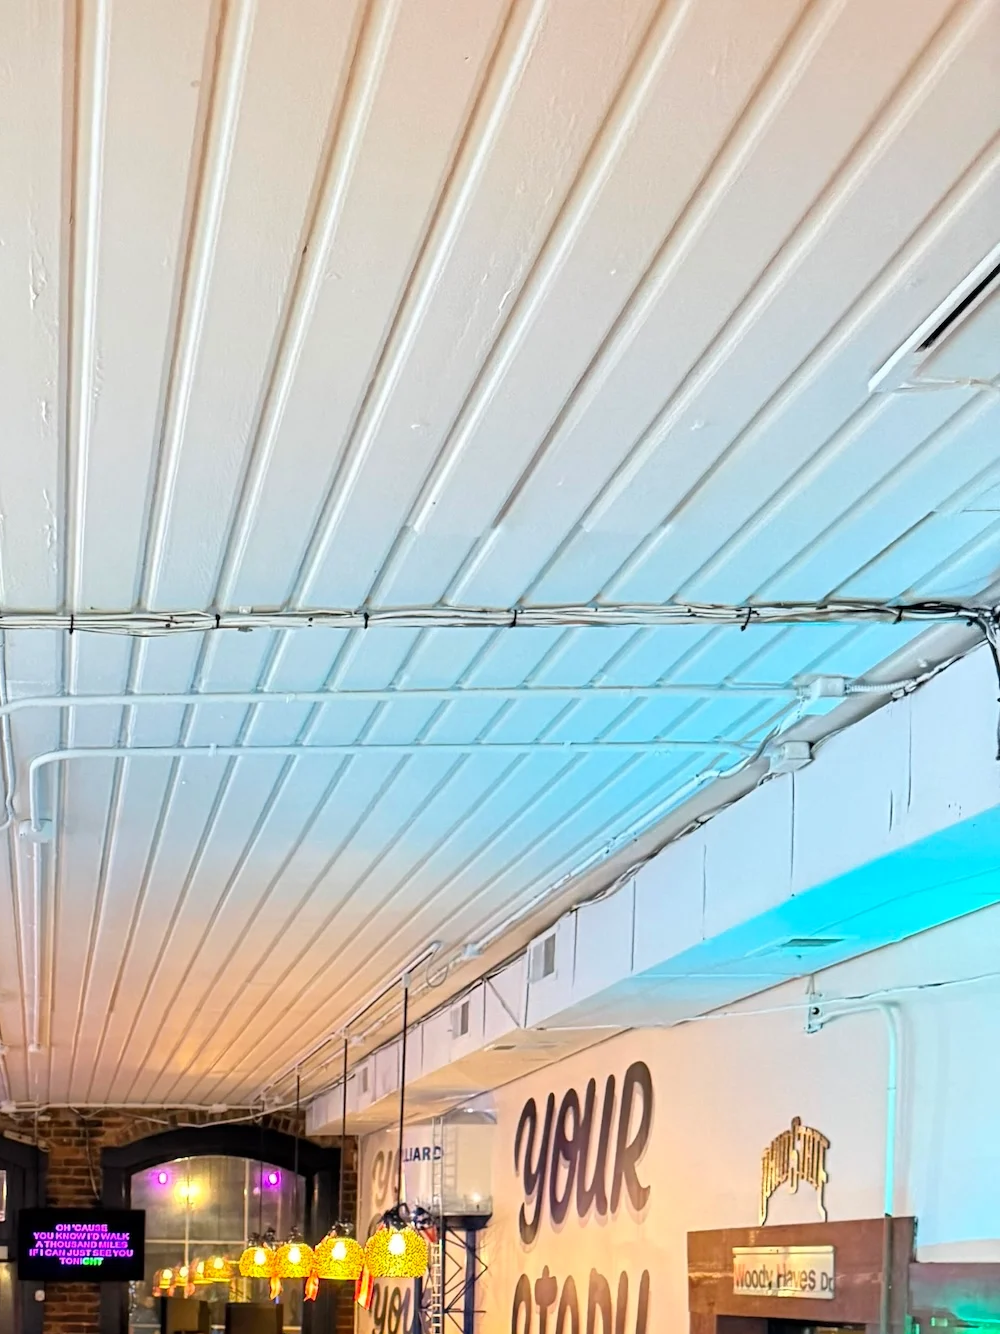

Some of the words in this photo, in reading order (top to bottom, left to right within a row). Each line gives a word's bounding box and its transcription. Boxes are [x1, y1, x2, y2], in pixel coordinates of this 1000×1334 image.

[514, 1060, 653, 1245] YOUR
[33, 1232, 54, 1240] YOU
[55, 1232, 86, 1240] KNOW
[44, 1240, 97, 1248] THOUSAND
[67, 1249, 91, 1257] JUST
[92, 1249, 112, 1257] SEE
[113, 1249, 134, 1257] YOU
[59, 1257, 104, 1266] TONIGHT
